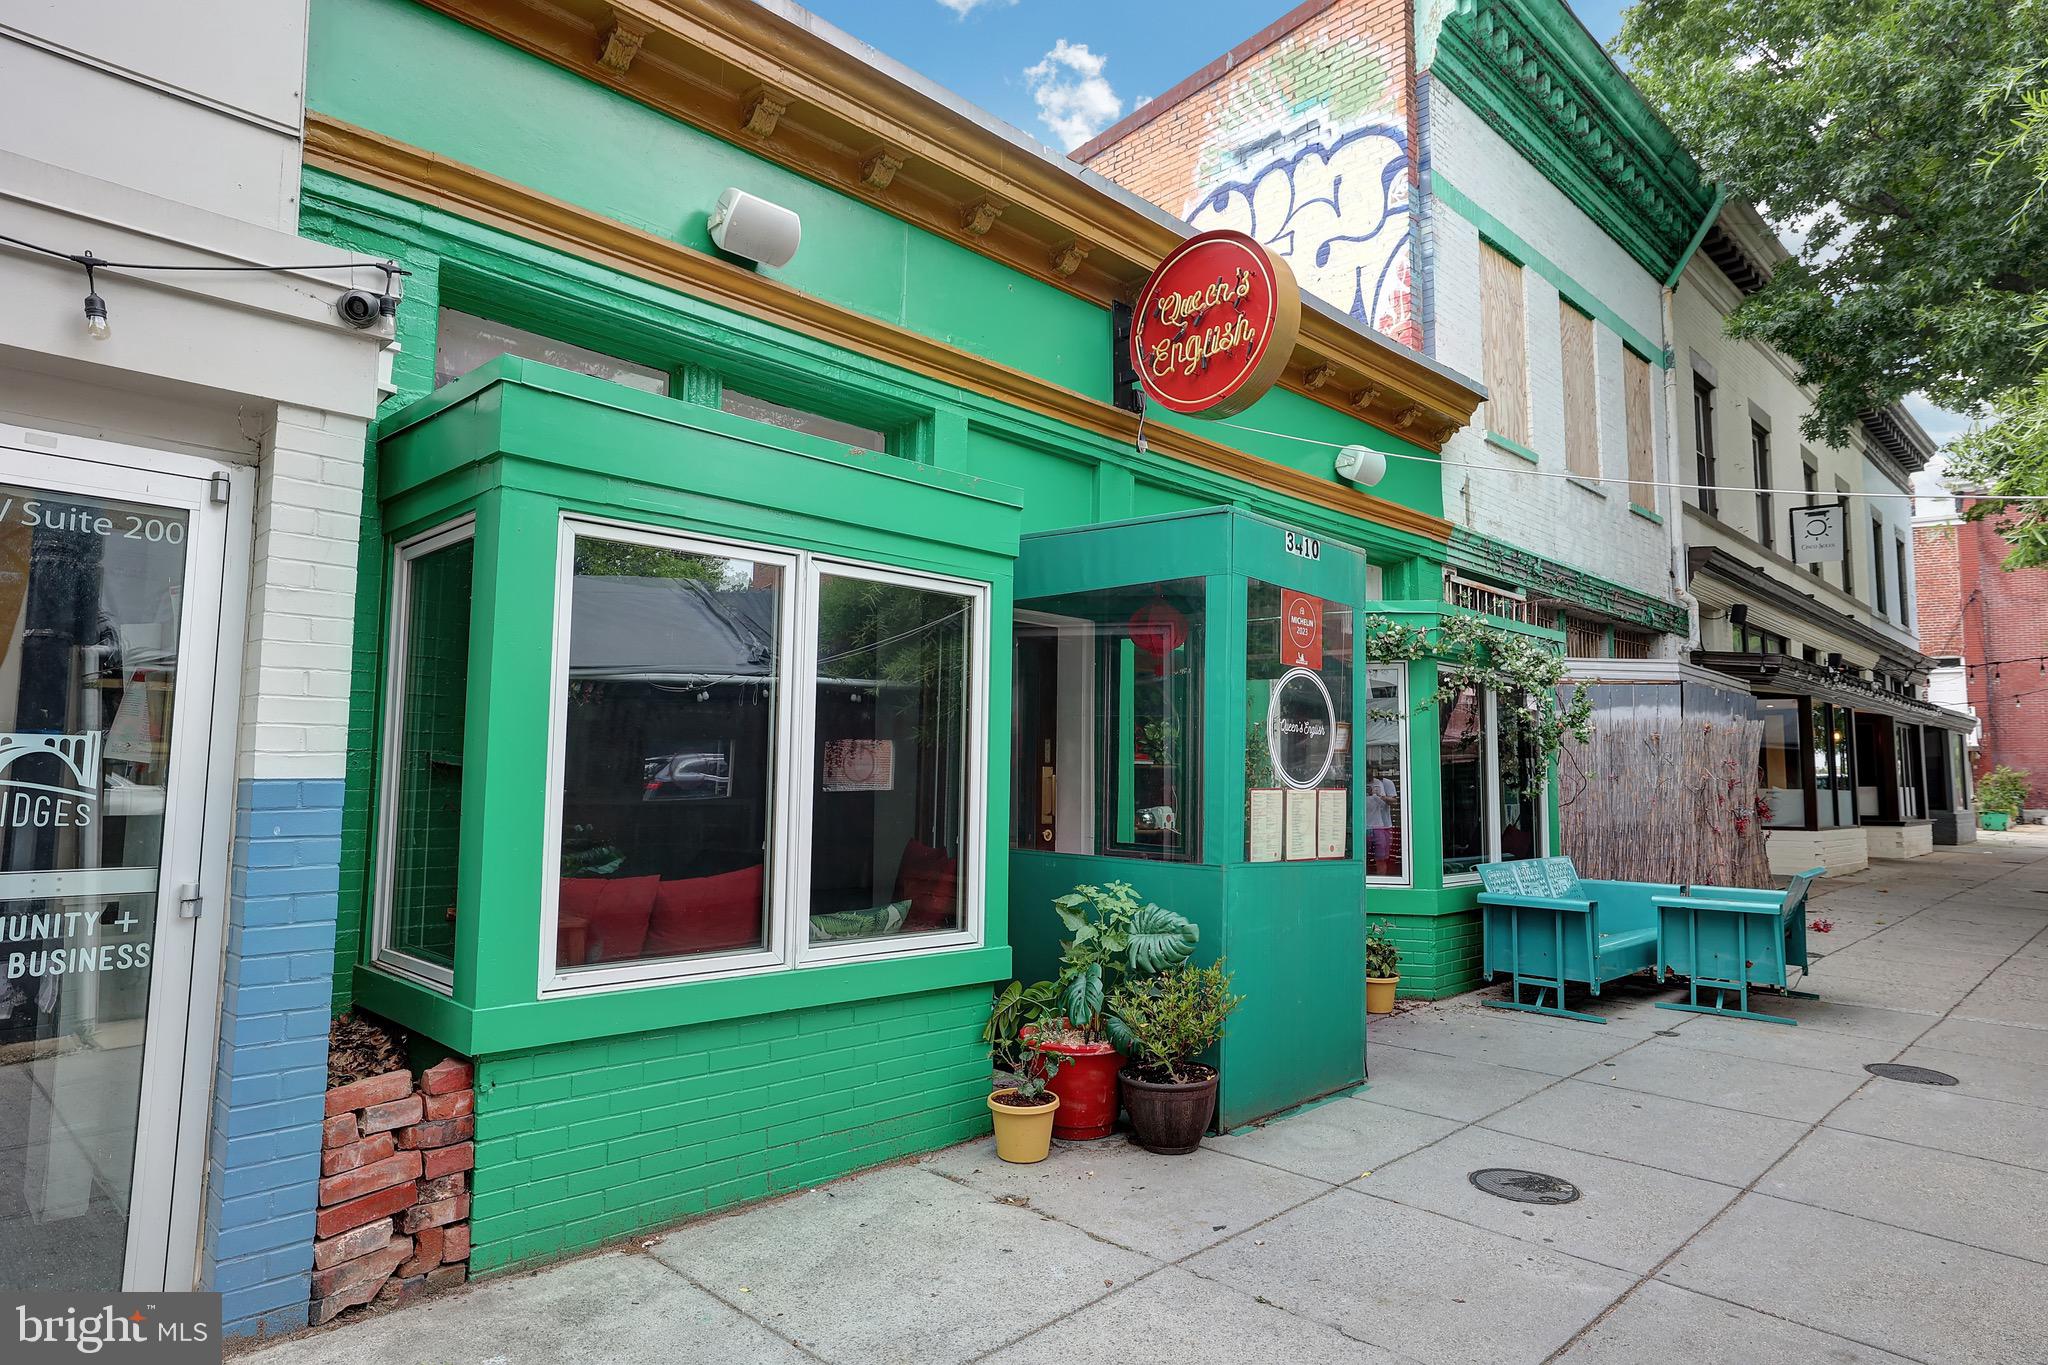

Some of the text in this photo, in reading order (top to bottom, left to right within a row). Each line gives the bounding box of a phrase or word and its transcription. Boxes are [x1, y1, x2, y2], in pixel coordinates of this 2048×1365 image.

[1158, 267, 1250, 326] Queen's
[1152, 314, 1255, 377] English
[21, 501, 113, 536] Suite
[123, 516, 185, 545] 200
[1287, 532, 1319, 559] 3410
[1291, 615, 1314, 628] MICHELIN
[0, 791, 91, 828] IDGES
[7, 943, 151, 979] BUSINESS
